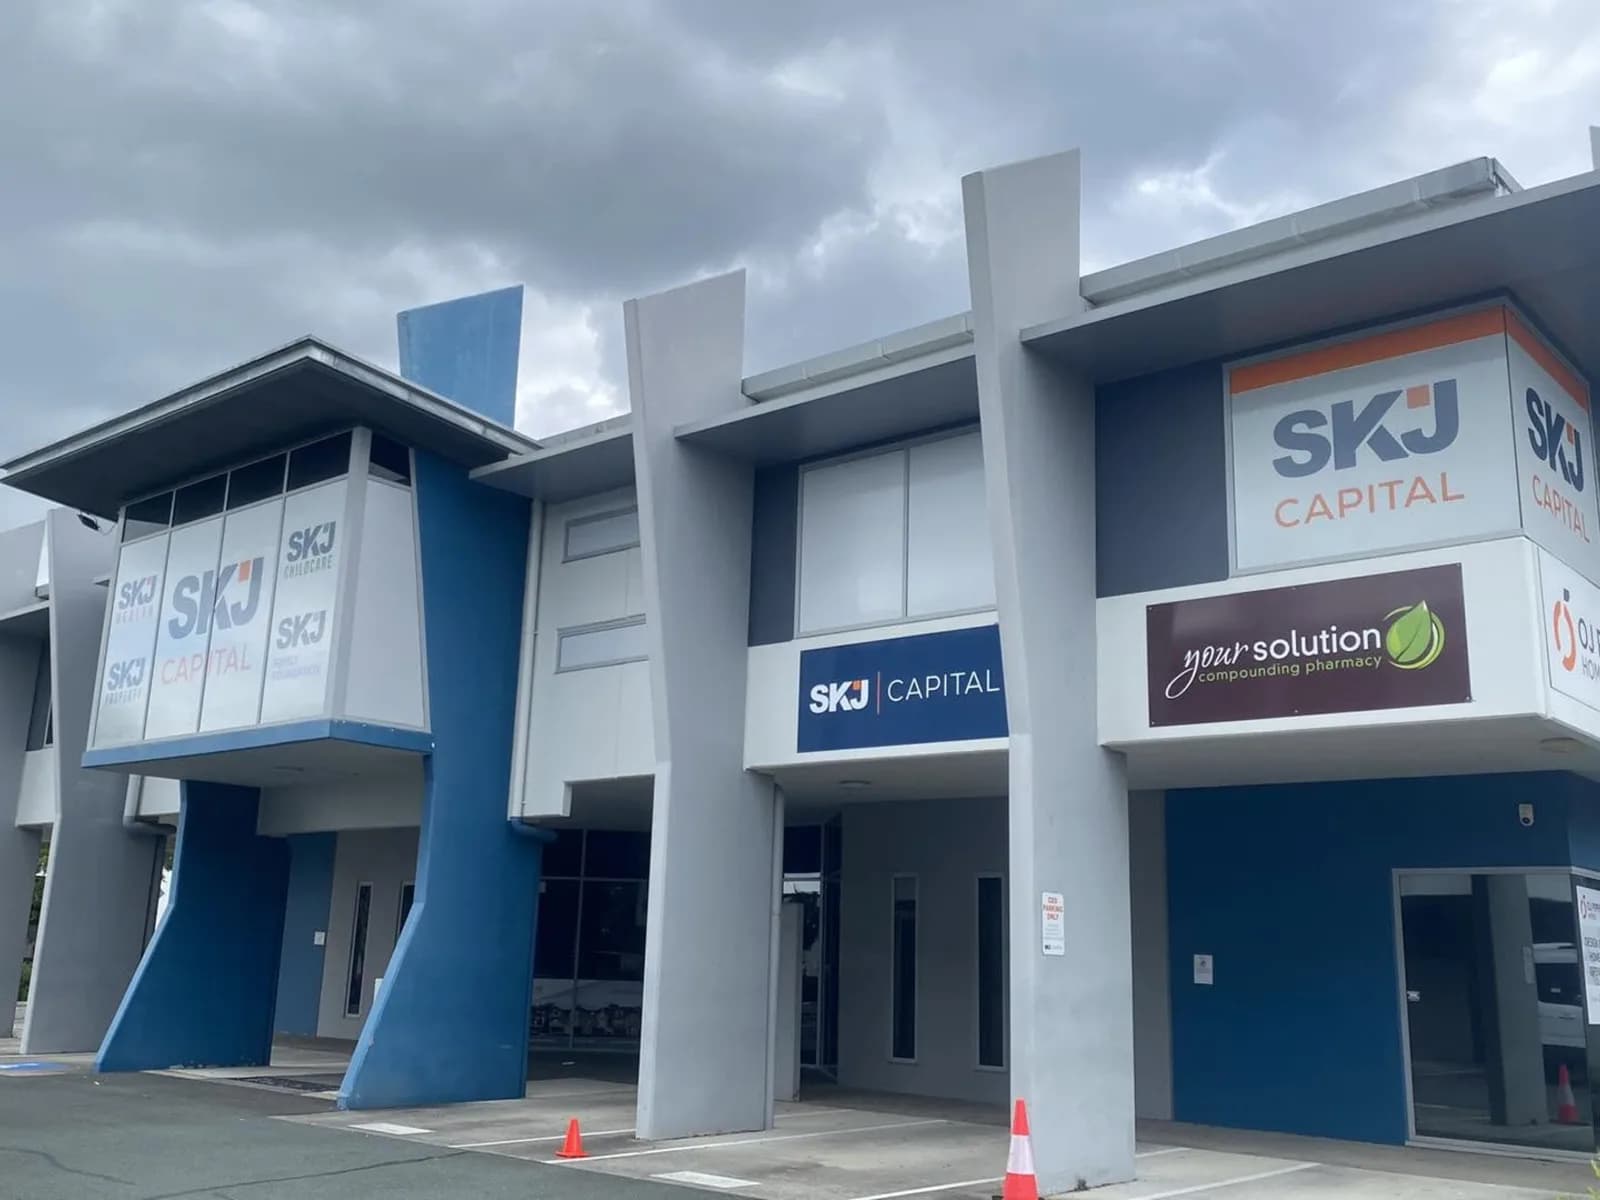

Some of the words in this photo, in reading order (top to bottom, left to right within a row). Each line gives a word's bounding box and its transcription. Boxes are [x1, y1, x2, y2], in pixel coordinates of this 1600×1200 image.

[1272, 378, 1460, 478] SKJ
[1526, 387, 1584, 492] SKJ
[1274, 472, 1465, 528] CAPITAL
[1532, 474, 1590, 543] CAPITAL
[287, 521, 337, 562] SKJ
[118, 575, 158, 610] SKJ
[168, 556, 264, 640] SKJ
[276, 610, 327, 650] SKJ
[107, 656, 146, 691] SKJ
[161, 643, 252, 685] CAPITAL
[1164, 642, 1249, 699] your
[1252, 625, 1381, 662] solution
[1198, 662, 1301, 683] compounding
[1305, 655, 1382, 674] pharmacy
[808, 679, 870, 714] SKJ
[887, 669, 1001, 702] CAPITAL
